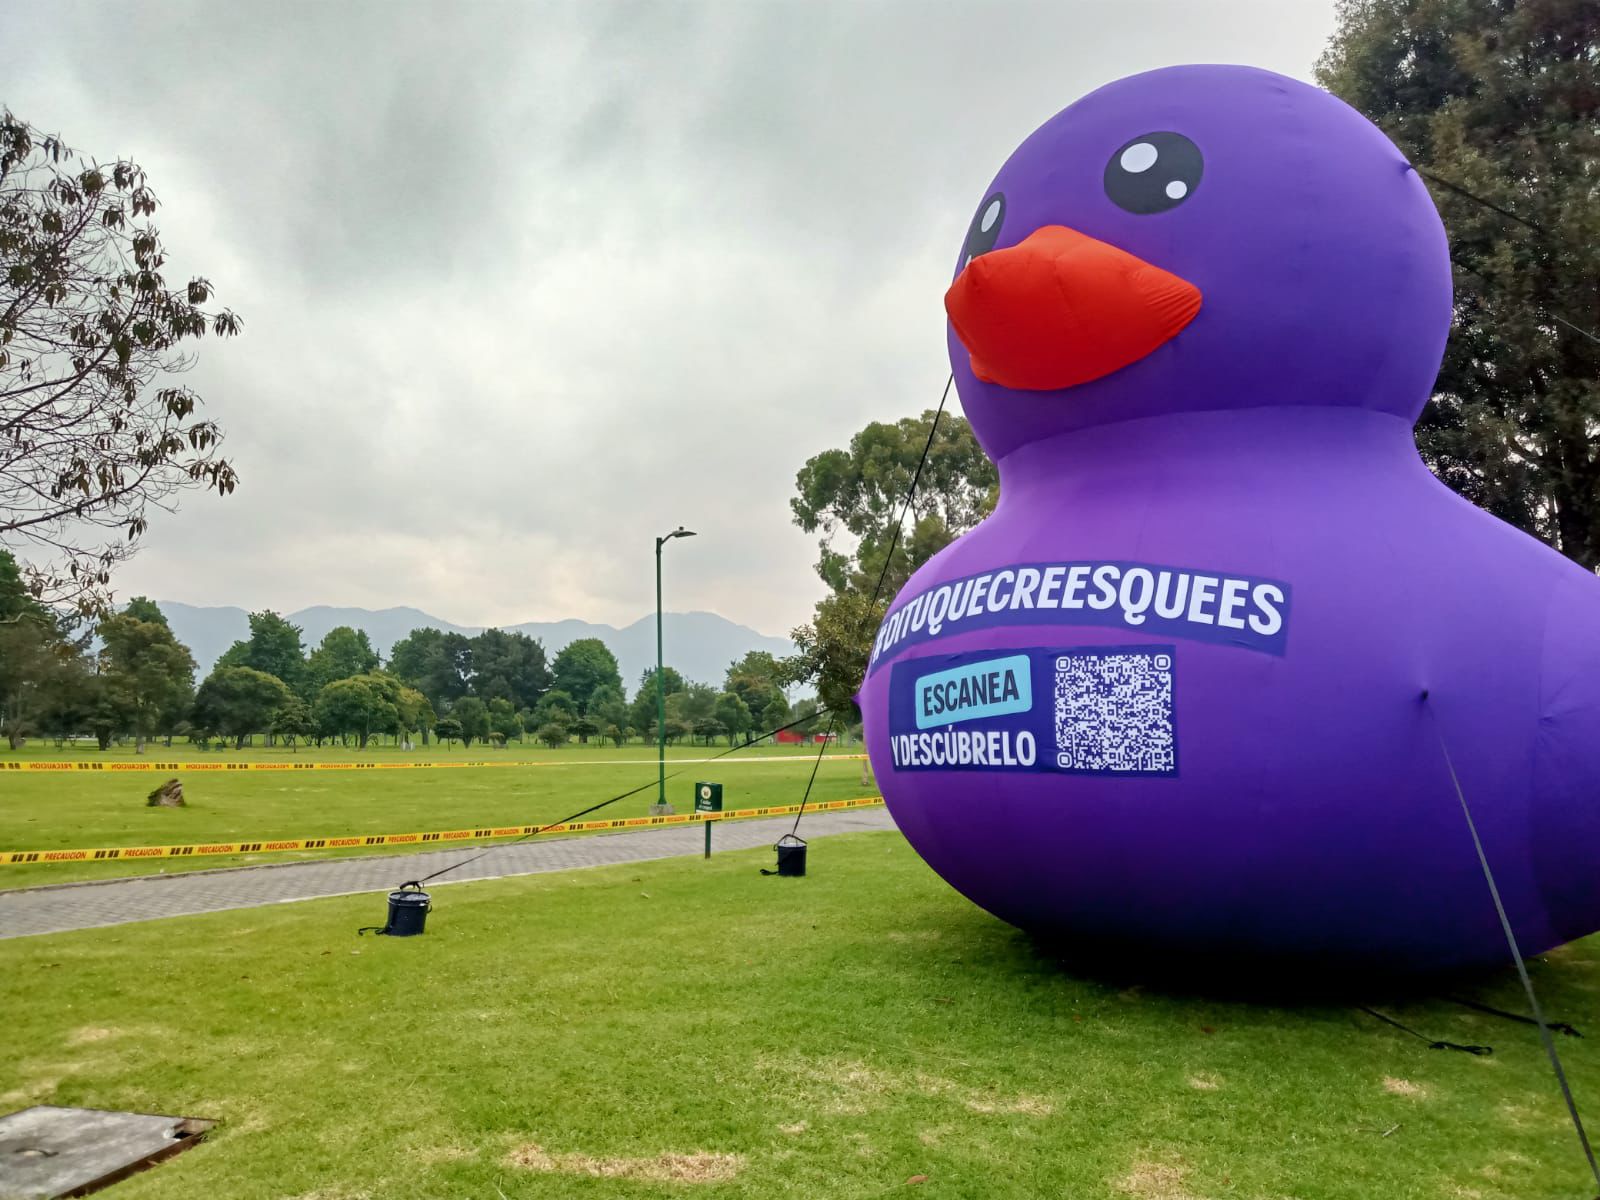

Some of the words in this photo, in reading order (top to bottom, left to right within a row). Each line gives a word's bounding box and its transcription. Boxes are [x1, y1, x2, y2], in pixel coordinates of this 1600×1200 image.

[872, 565, 1285, 664] #DITUQUECREESQUEES
[923, 669, 1020, 716] ESCANEA
[891, 735, 902, 767] Y
[901, 725, 1036, 766] DESCÚBRELO
